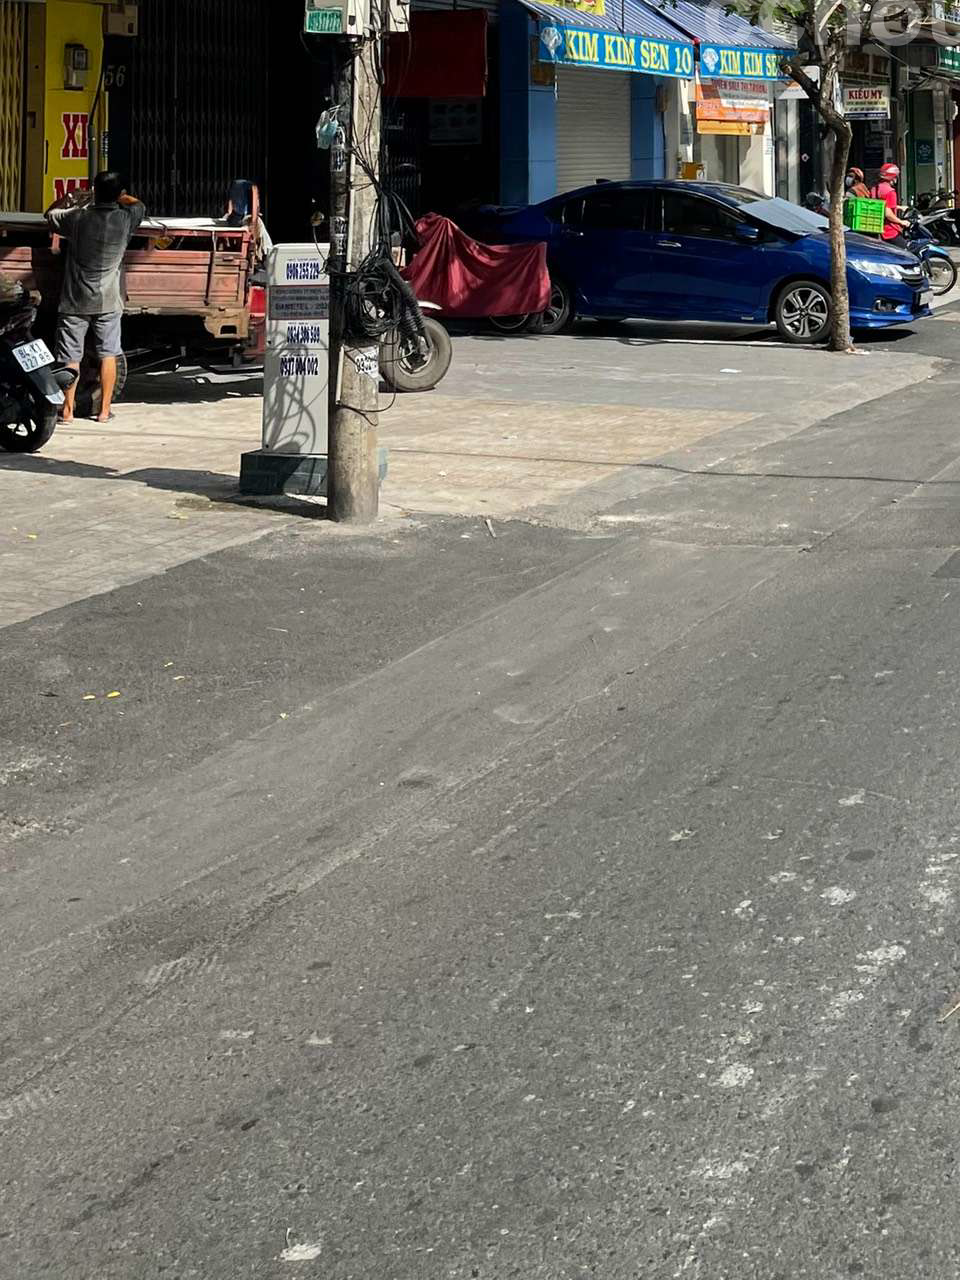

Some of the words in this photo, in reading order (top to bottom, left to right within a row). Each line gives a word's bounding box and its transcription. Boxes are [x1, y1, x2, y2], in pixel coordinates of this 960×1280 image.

[564, 29, 599, 63] KIM
[604, 33, 635, 66] KIM
[641, 40, 669, 70] SEN
[674, 46, 692, 75] 10
[719, 49, 741, 75] KIM
[743, 50, 764, 76] KIM
